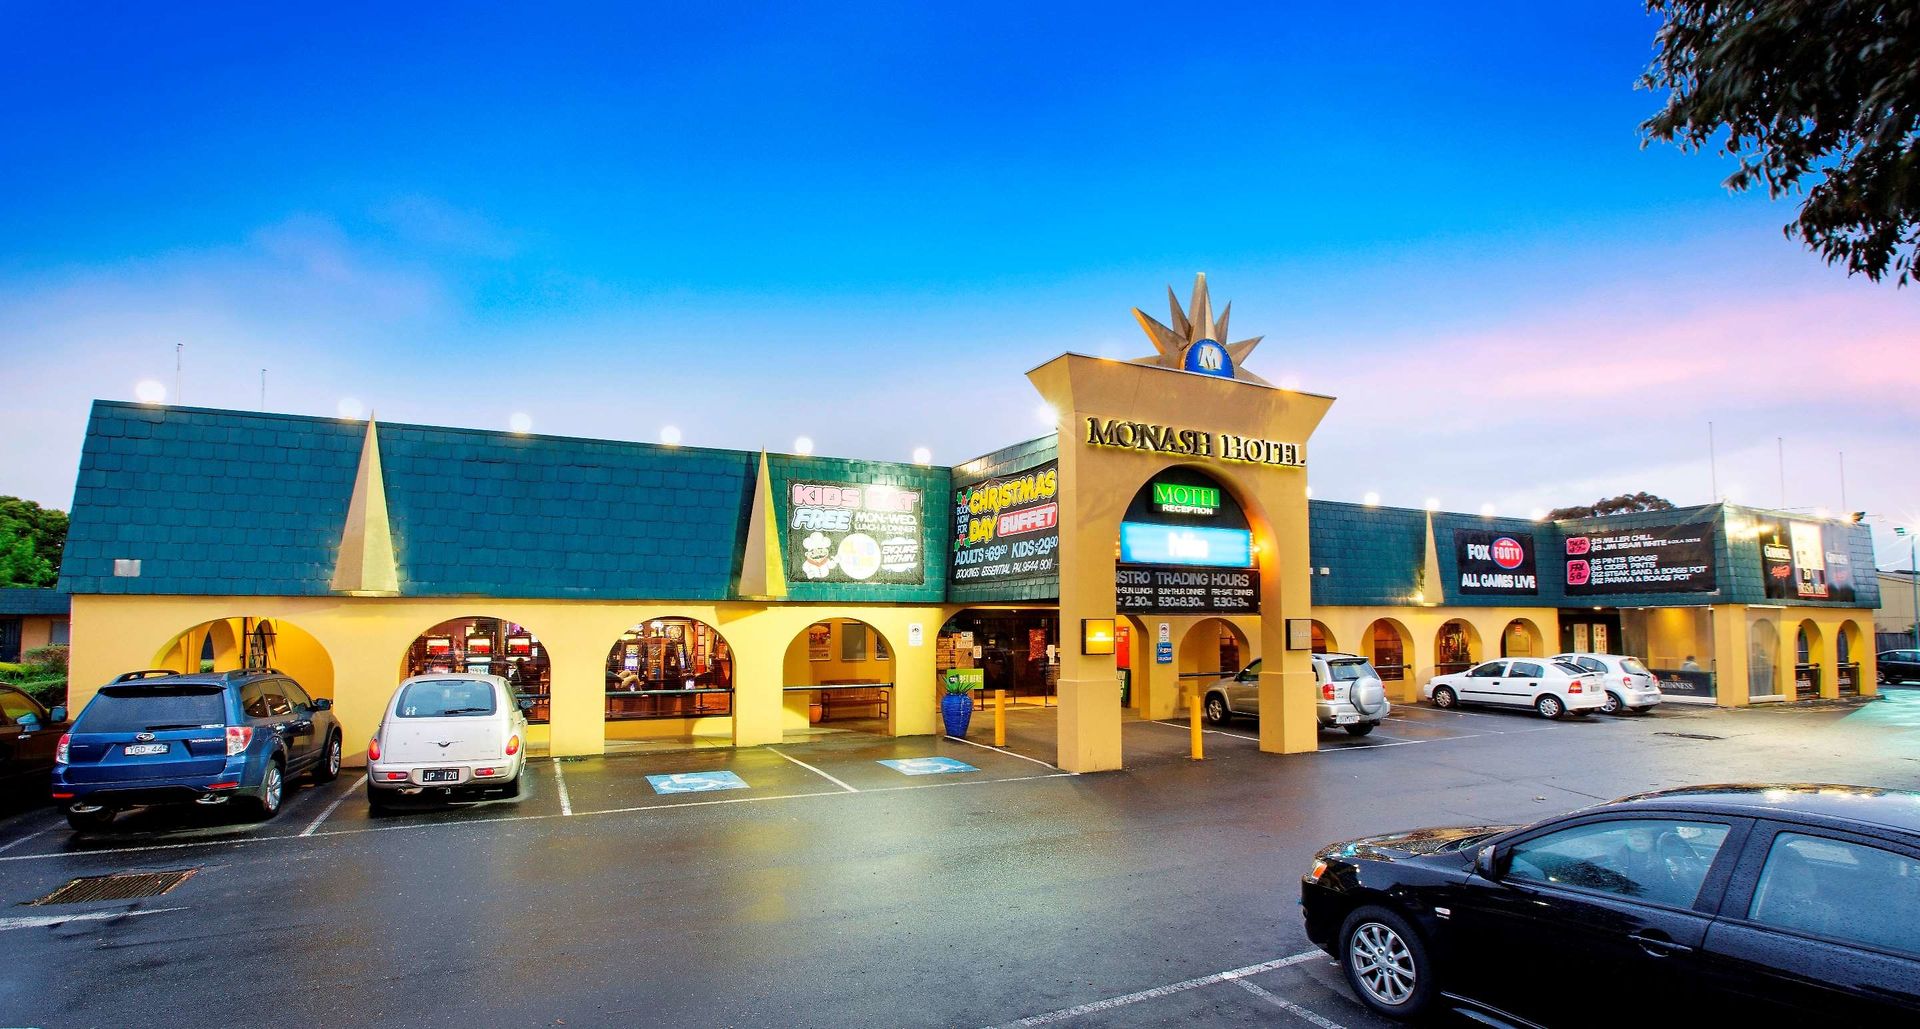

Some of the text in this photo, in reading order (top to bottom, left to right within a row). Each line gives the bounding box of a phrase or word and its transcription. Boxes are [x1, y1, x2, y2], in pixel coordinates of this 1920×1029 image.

[1198, 345, 1222, 370] M
[1087, 417, 1307, 467] MONASH HOTEL
[793, 483, 861, 509] KIDS
[968, 468, 1057, 515] CHRISTMAS
[1155, 484, 1220, 507] MOTEL
[1162, 503, 1213, 515] RECEPTION
[791, 506, 853, 532] FREE
[957, 514, 969, 524] NOW
[1000, 505, 1056, 536] BUFFET
[957, 523, 967, 534] FOR
[968, 515, 997, 545] DAY
[1603, 535, 1630, 543] MILLER
[1617, 541, 1642, 549] BEAM
[1643, 539, 1667, 547] WHITE
[954, 548, 985, 566] ADULTS
[1011, 540, 1035, 559] KIDS
[1467, 543, 1520, 560] FOX FOOTY
[956, 567, 980, 579] BOOKINGS
[980, 563, 1010, 577] ESSENTIAL
[1689, 565, 1708, 573] POT
[1116, 570, 1249, 587] ISTRO TRADING HOURS
[1461, 573, 1536, 589] ALL GAMES LIVE
[1604, 576, 1635, 584] PARMA
[1643, 574, 1672, 582] BOAGS
[1673, 573, 1692, 581] POT
[424, 771, 458, 781] JP 120
